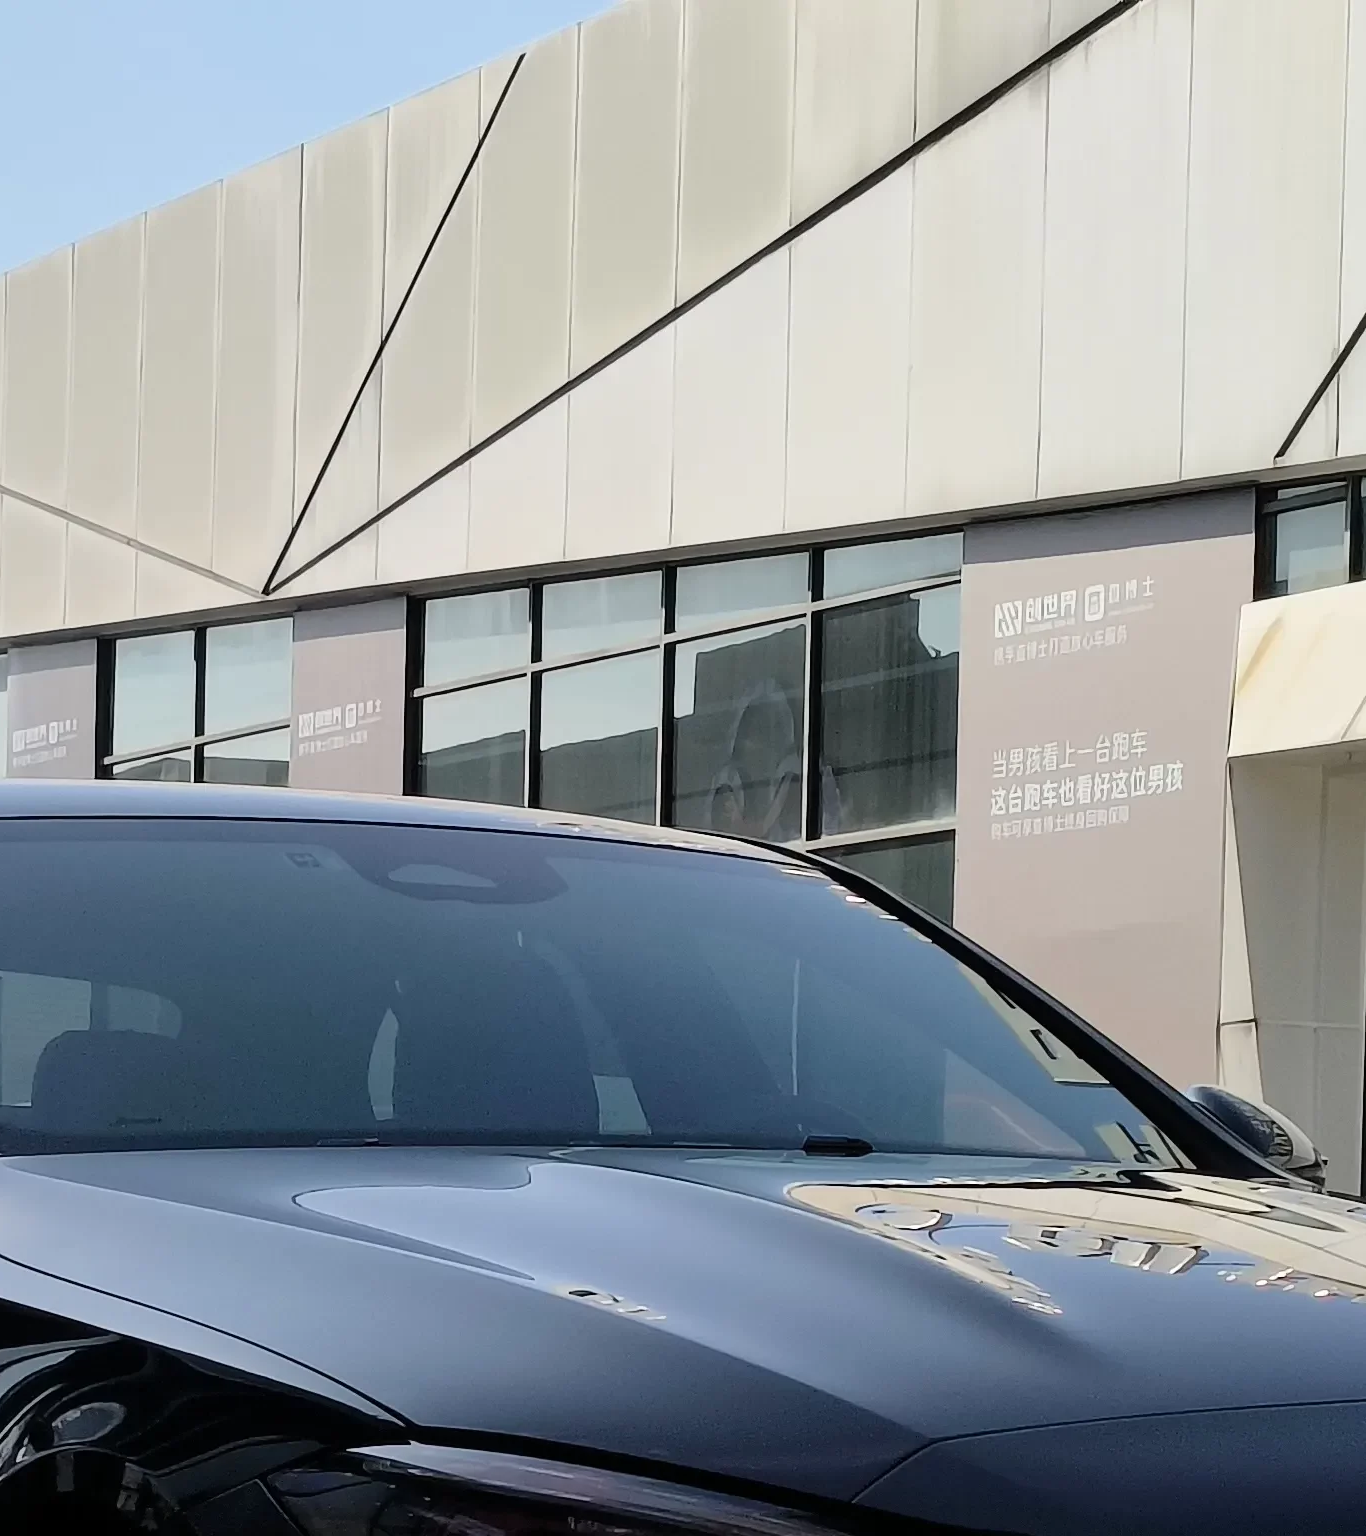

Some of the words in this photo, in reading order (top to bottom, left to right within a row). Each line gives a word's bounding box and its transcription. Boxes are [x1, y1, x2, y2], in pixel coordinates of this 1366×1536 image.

[991, 728, 1149, 779] 当男孩看上一台跑车
[990, 759, 1185, 816] 这台跑车也看好这位男孩
